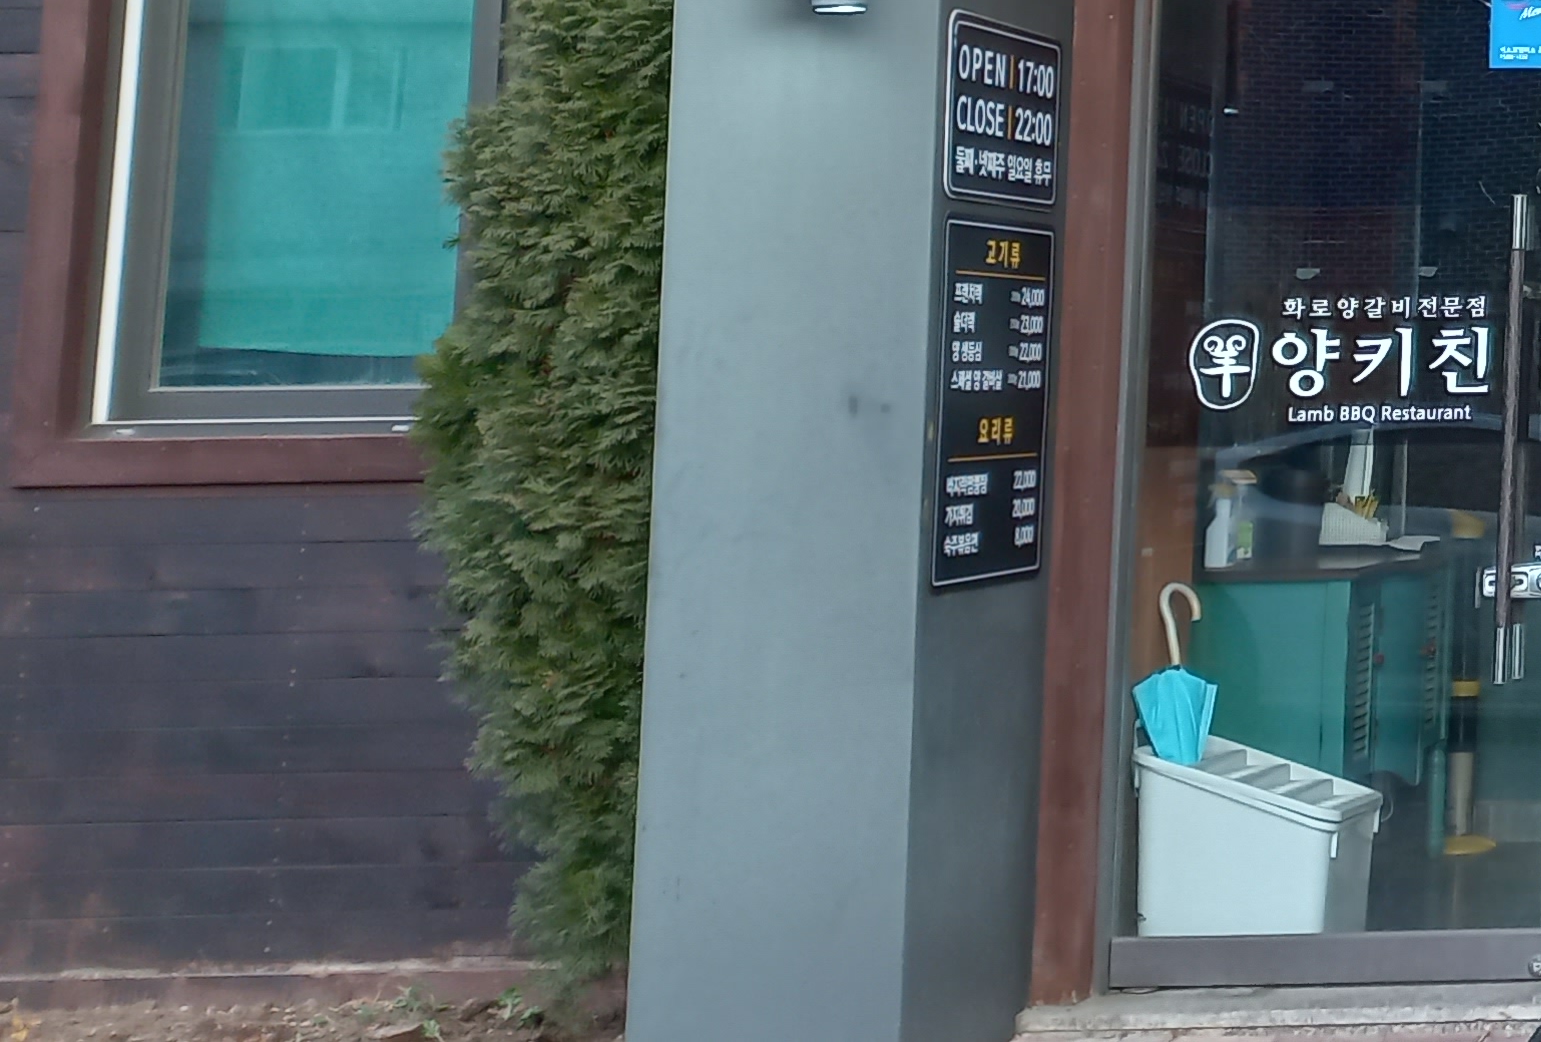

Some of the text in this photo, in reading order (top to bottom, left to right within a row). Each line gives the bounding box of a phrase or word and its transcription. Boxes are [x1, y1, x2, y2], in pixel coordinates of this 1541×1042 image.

[958, 44, 1054, 99] OPEN 17:00
[956, 95, 1052, 146] CLOSE 22:00
[1007, 154, 1033, 184] 일요일
[1034, 158, 1052, 187] 휴무
[985, 240, 1021, 269] 고기류
[1021, 287, 1045, 308] 24,000
[1282, 296, 1487, 319] 화로양갈비전문점
[1020, 314, 1043, 336] 23,000
[1018, 342, 1042, 363] 22,000
[1271, 326, 1489, 398] 양키친
[1017, 370, 1041, 391] 21,000
[1288, 405, 1472, 425] Lamb BBQ Restaurant
[978, 417, 1014, 445] 요리류
[1013, 469, 1036, 491] 22,000
[1012, 497, 1035, 519] 20,000
[1014, 525, 1035, 546] 8,000
